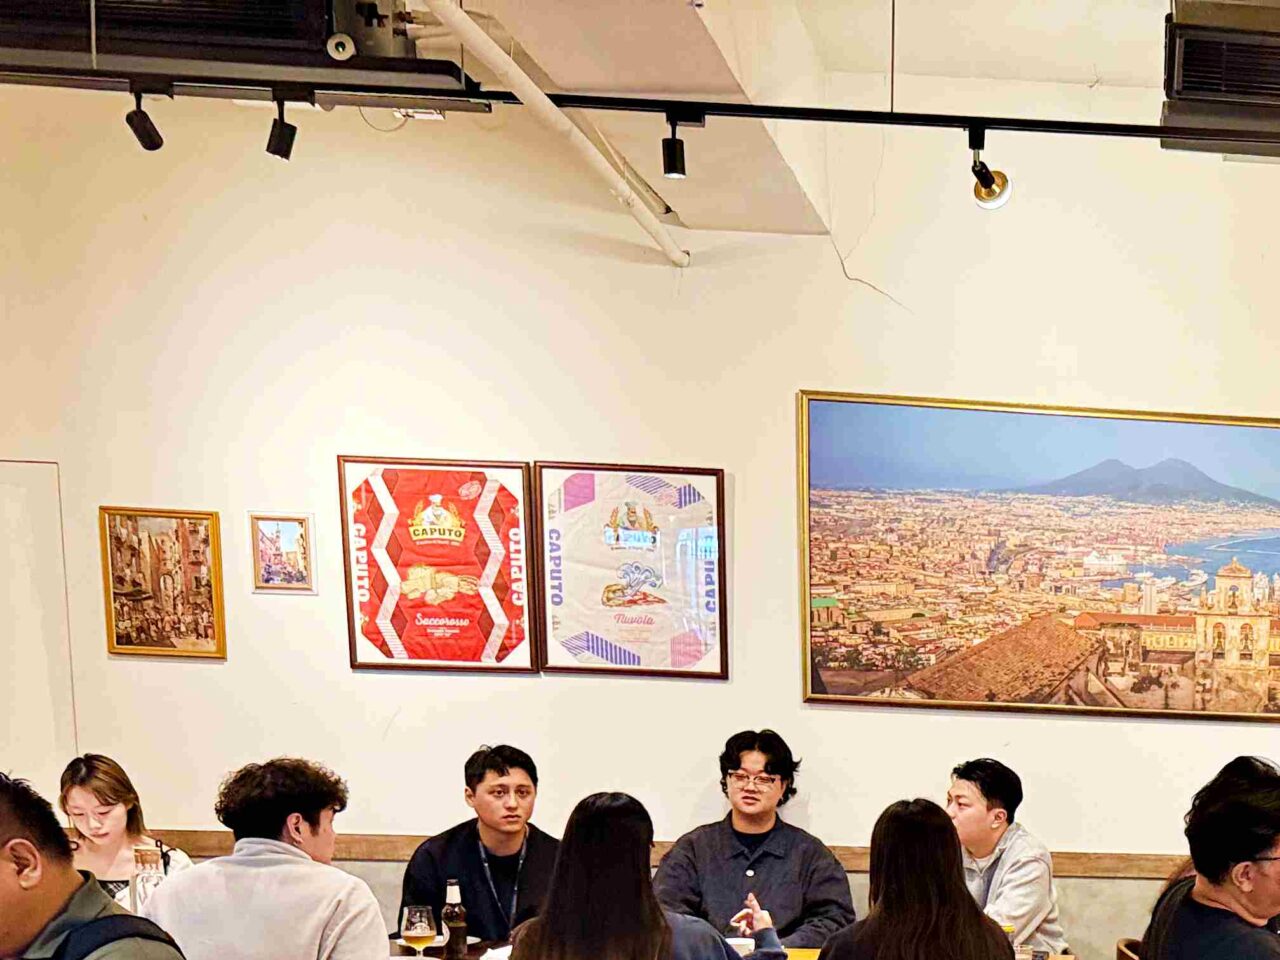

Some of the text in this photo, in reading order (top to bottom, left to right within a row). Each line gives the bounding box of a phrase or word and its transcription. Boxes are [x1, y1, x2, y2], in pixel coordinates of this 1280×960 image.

[412, 527, 463, 538] CAPUTO
[353, 522, 370, 603] CAPUTO
[510, 527, 525, 606] CAPUTO
[547, 528, 563, 606] CAPUTO
[415, 612, 470, 626] Saccorosso
[613, 613, 656, 625] Nuvola
